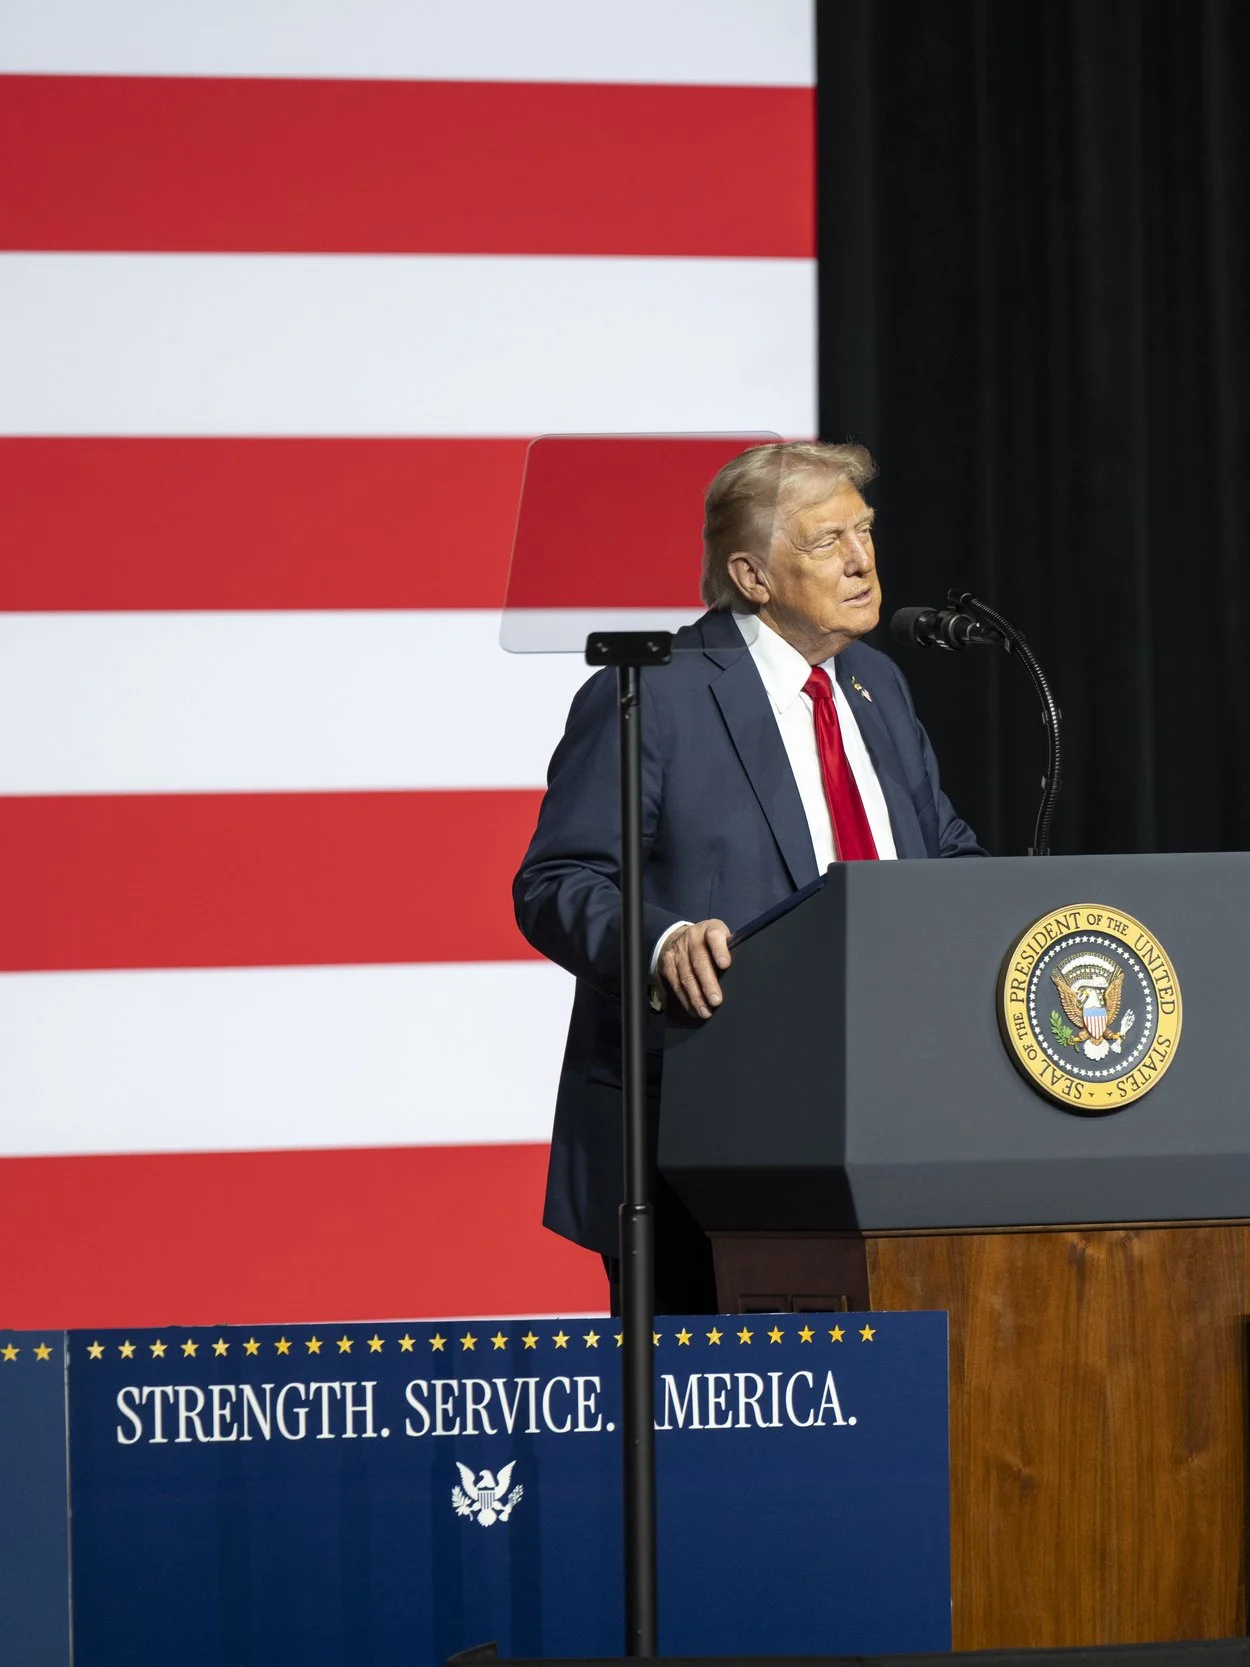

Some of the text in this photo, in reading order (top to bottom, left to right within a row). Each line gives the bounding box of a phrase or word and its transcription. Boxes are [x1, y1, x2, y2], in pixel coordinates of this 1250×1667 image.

[1010, 911, 1176, 1100] SEAL OF THE PRESIDENT OF THE UNITED STATES
[116, 1370, 858, 1445] STRENGTH. SERVICE. MERICA.
